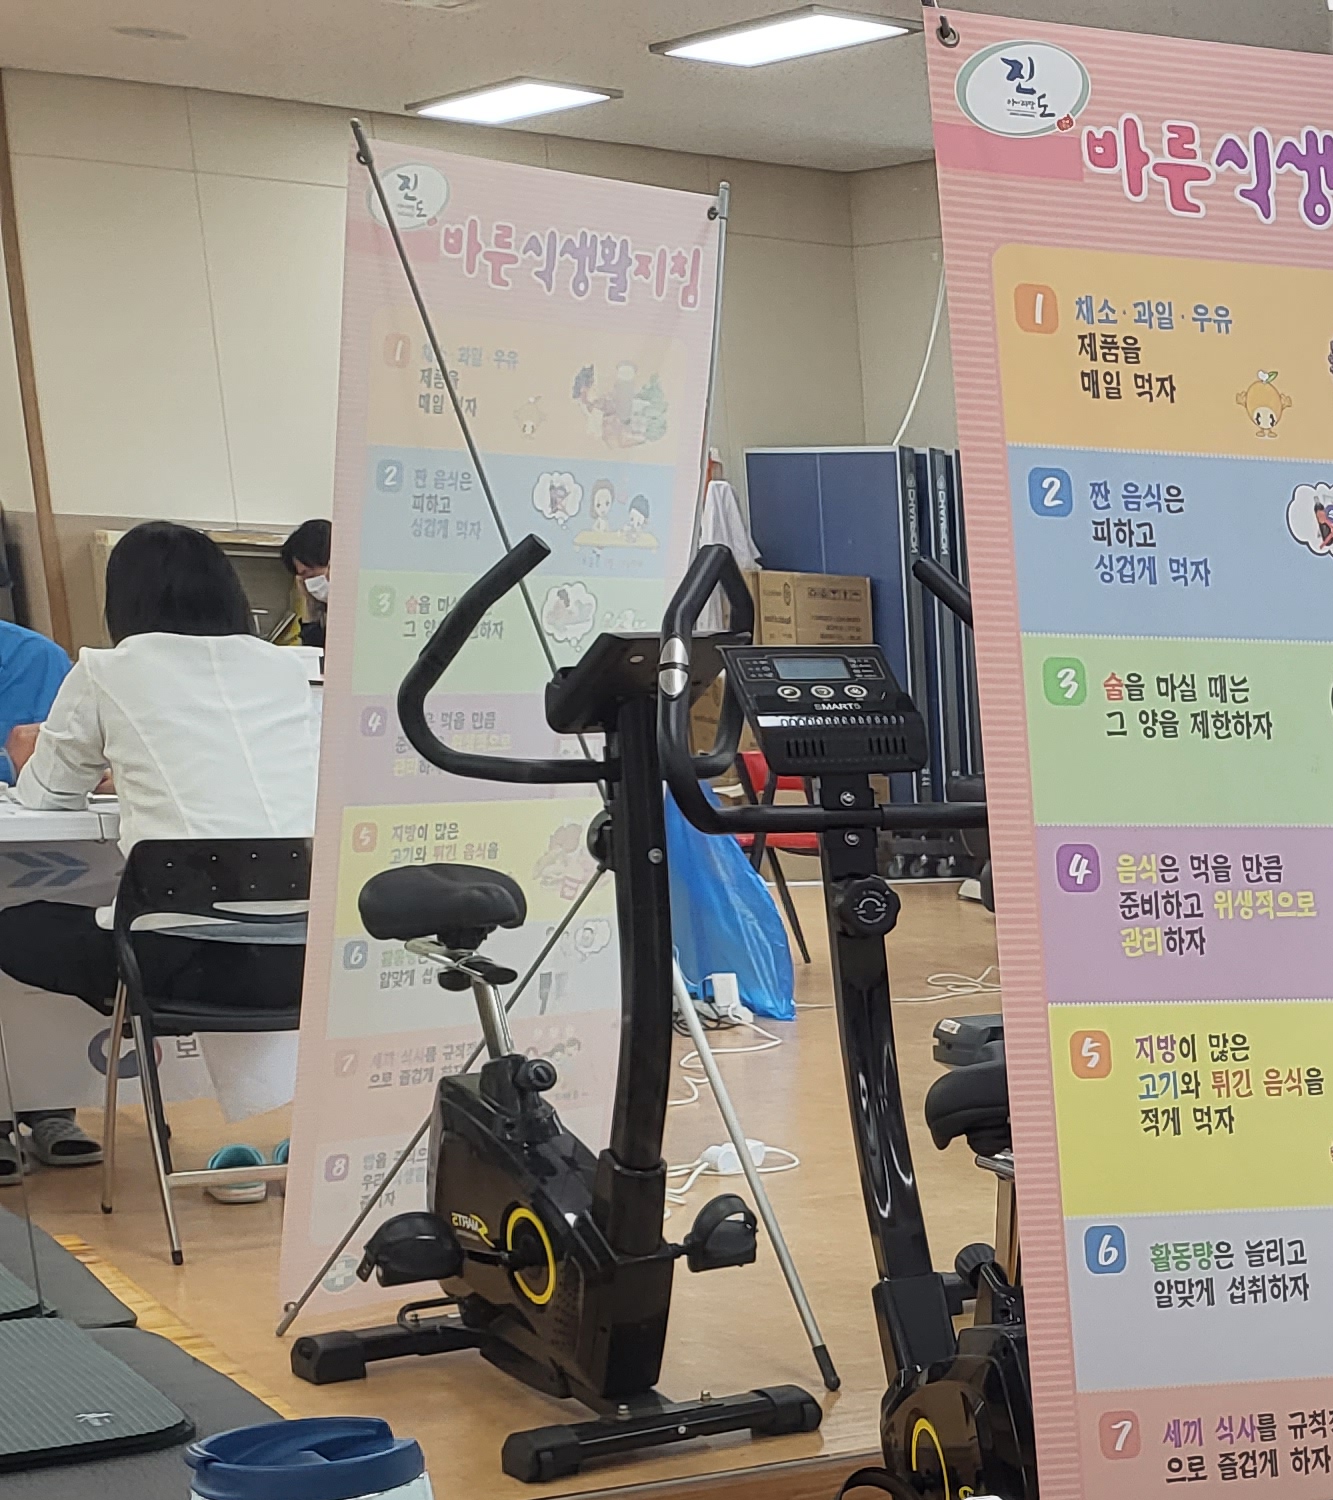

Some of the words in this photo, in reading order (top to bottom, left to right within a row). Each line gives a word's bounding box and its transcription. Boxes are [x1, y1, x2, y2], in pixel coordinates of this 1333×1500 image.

[1077, 332, 1142, 364] 제품을
[1079, 368, 1122, 400] 매일
[1132, 371, 1176, 403] 먹자
[384, 465, 397, 486] 2
[1039, 476, 1064, 508] 2
[1088, 481, 1112, 512] 짠
[1121, 482, 1185, 515] 음식은
[1092, 518, 1157, 549] 피하고
[1094, 553, 1158, 586] 싱겁게
[1168, 557, 1211, 587] 먹자
[1057, 667, 1079, 699] 3
[1103, 672, 1145, 702] 술을
[1157, 673, 1197, 703] 마실
[1208, 674, 1250, 704] 때는
[1106, 712, 1128, 737] 그
[1138, 710, 1180, 739] 양을
[1190, 709, 1274, 741] 제한하자
[359, 828, 371, 846] 5
[1068, 852, 1094, 885] 4
[1115, 854, 1180, 886] 음식은
[1190, 854, 1233, 884] 먹을
[1241, 853, 1284, 884] 만큼
[1118, 890, 1204, 920] 준비하고
[1212, 887, 1318, 919] 위생적으로
[350, 947, 363, 964] 6
[1120, 927, 1207, 959] 관리하자
[1080, 1036, 1102, 1069] 5
[1135, 1033, 1198, 1064] 지방이
[1208, 1032, 1251, 1064] 많은
[1138, 1070, 1201, 1101] 고기와
[1210, 1068, 1254, 1099] 튀긴
[1263, 1066, 1326, 1098] 음식을
[1139, 1105, 1182, 1137] 적게
[1192, 1104, 1236, 1135] 먹자
[331, 1158, 346, 1175] 8
[1097, 1233, 1119, 1268] 6
[1149, 1239, 1235, 1273] 활동량은
[1245, 1237, 1308, 1268] 늘리고
[1153, 1277, 1217, 1309] 알맞게
[1226, 1274, 1311, 1307] 섭취하자
[1110, 1418, 1133, 1452] 7
[1162, 1418, 1205, 1450] 세끼
[1214, 1412, 1277, 1447] 식사를
[1165, 1455, 1209, 1485] 으로
[1217, 1449, 1280, 1483] 즐겁게
[1291, 1445, 1332, 1477] 하자
